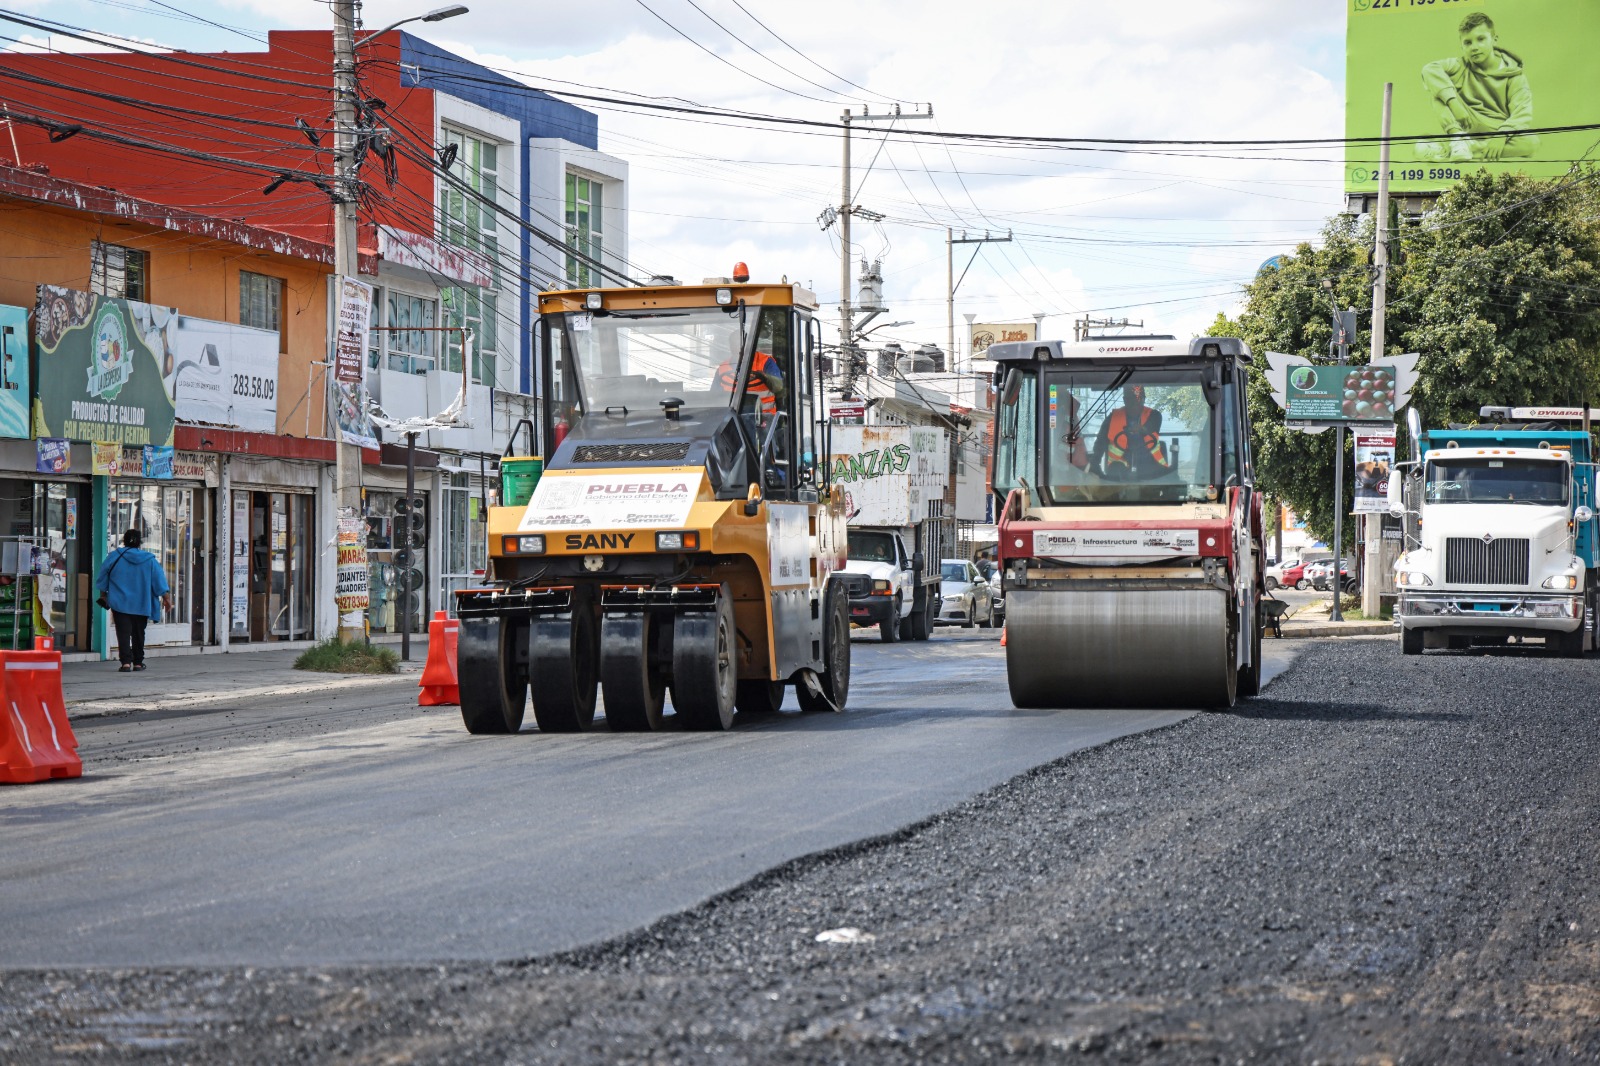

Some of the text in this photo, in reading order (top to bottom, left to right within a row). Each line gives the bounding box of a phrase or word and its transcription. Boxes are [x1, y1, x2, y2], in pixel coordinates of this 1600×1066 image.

[1371, 168, 1460, 180] 21 199 5998
[1002, 330, 1028, 342] Little
[72, 401, 145, 425] PRODUCTOS DE CALIDAD
[64, 420, 150, 444] CON PRECIOS DE LA CENTRAL
[586, 483, 689, 494] PUEBLA
[566, 533, 636, 550] SANY
